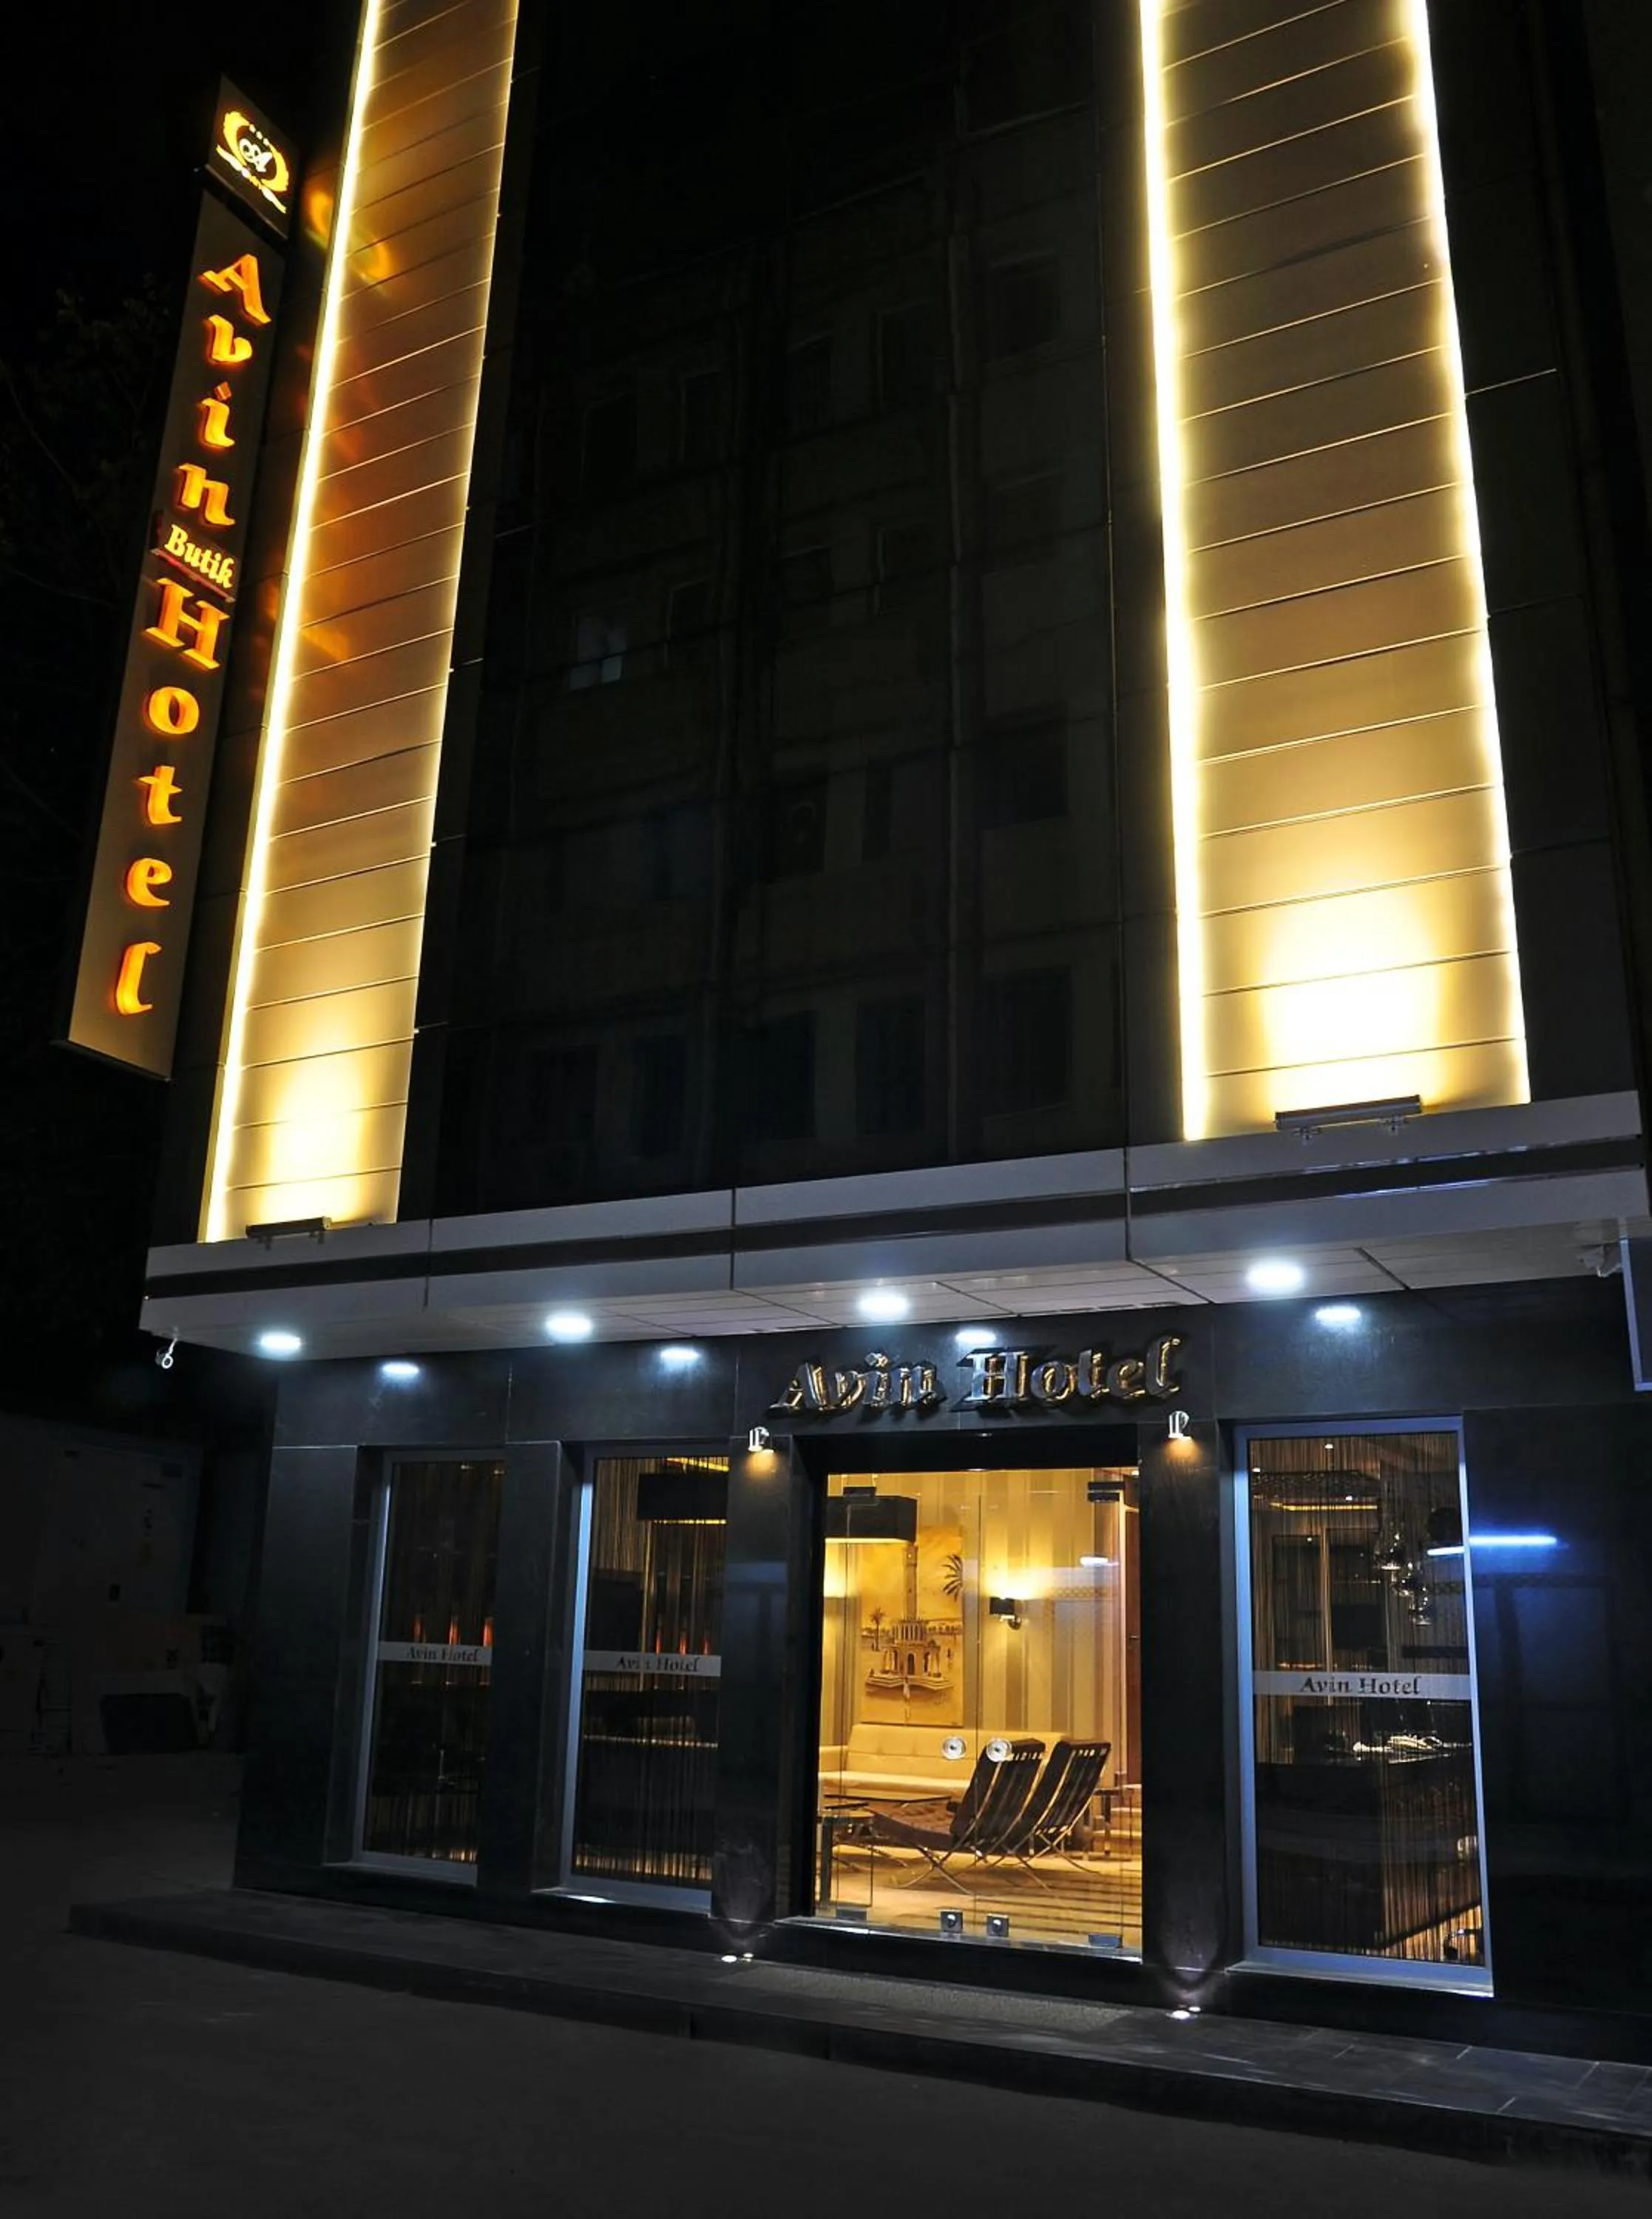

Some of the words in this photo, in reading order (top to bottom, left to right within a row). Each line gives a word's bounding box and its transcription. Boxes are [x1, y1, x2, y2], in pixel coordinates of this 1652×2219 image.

[177, 253, 271, 527] Avin
[164, 524, 234, 589] Butik
[116, 577, 230, 1016] Hotel
[771, 1351, 938, 1411] Avin
[959, 1335, 1184, 1402] Hotel
[407, 1645, 438, 1661] Avin
[441, 1647, 479, 1663] Hotel
[656, 1656, 700, 1672] Hotel
[1300, 1676, 1353, 1694] Avin
[1358, 1676, 1422, 1695] Hotel
